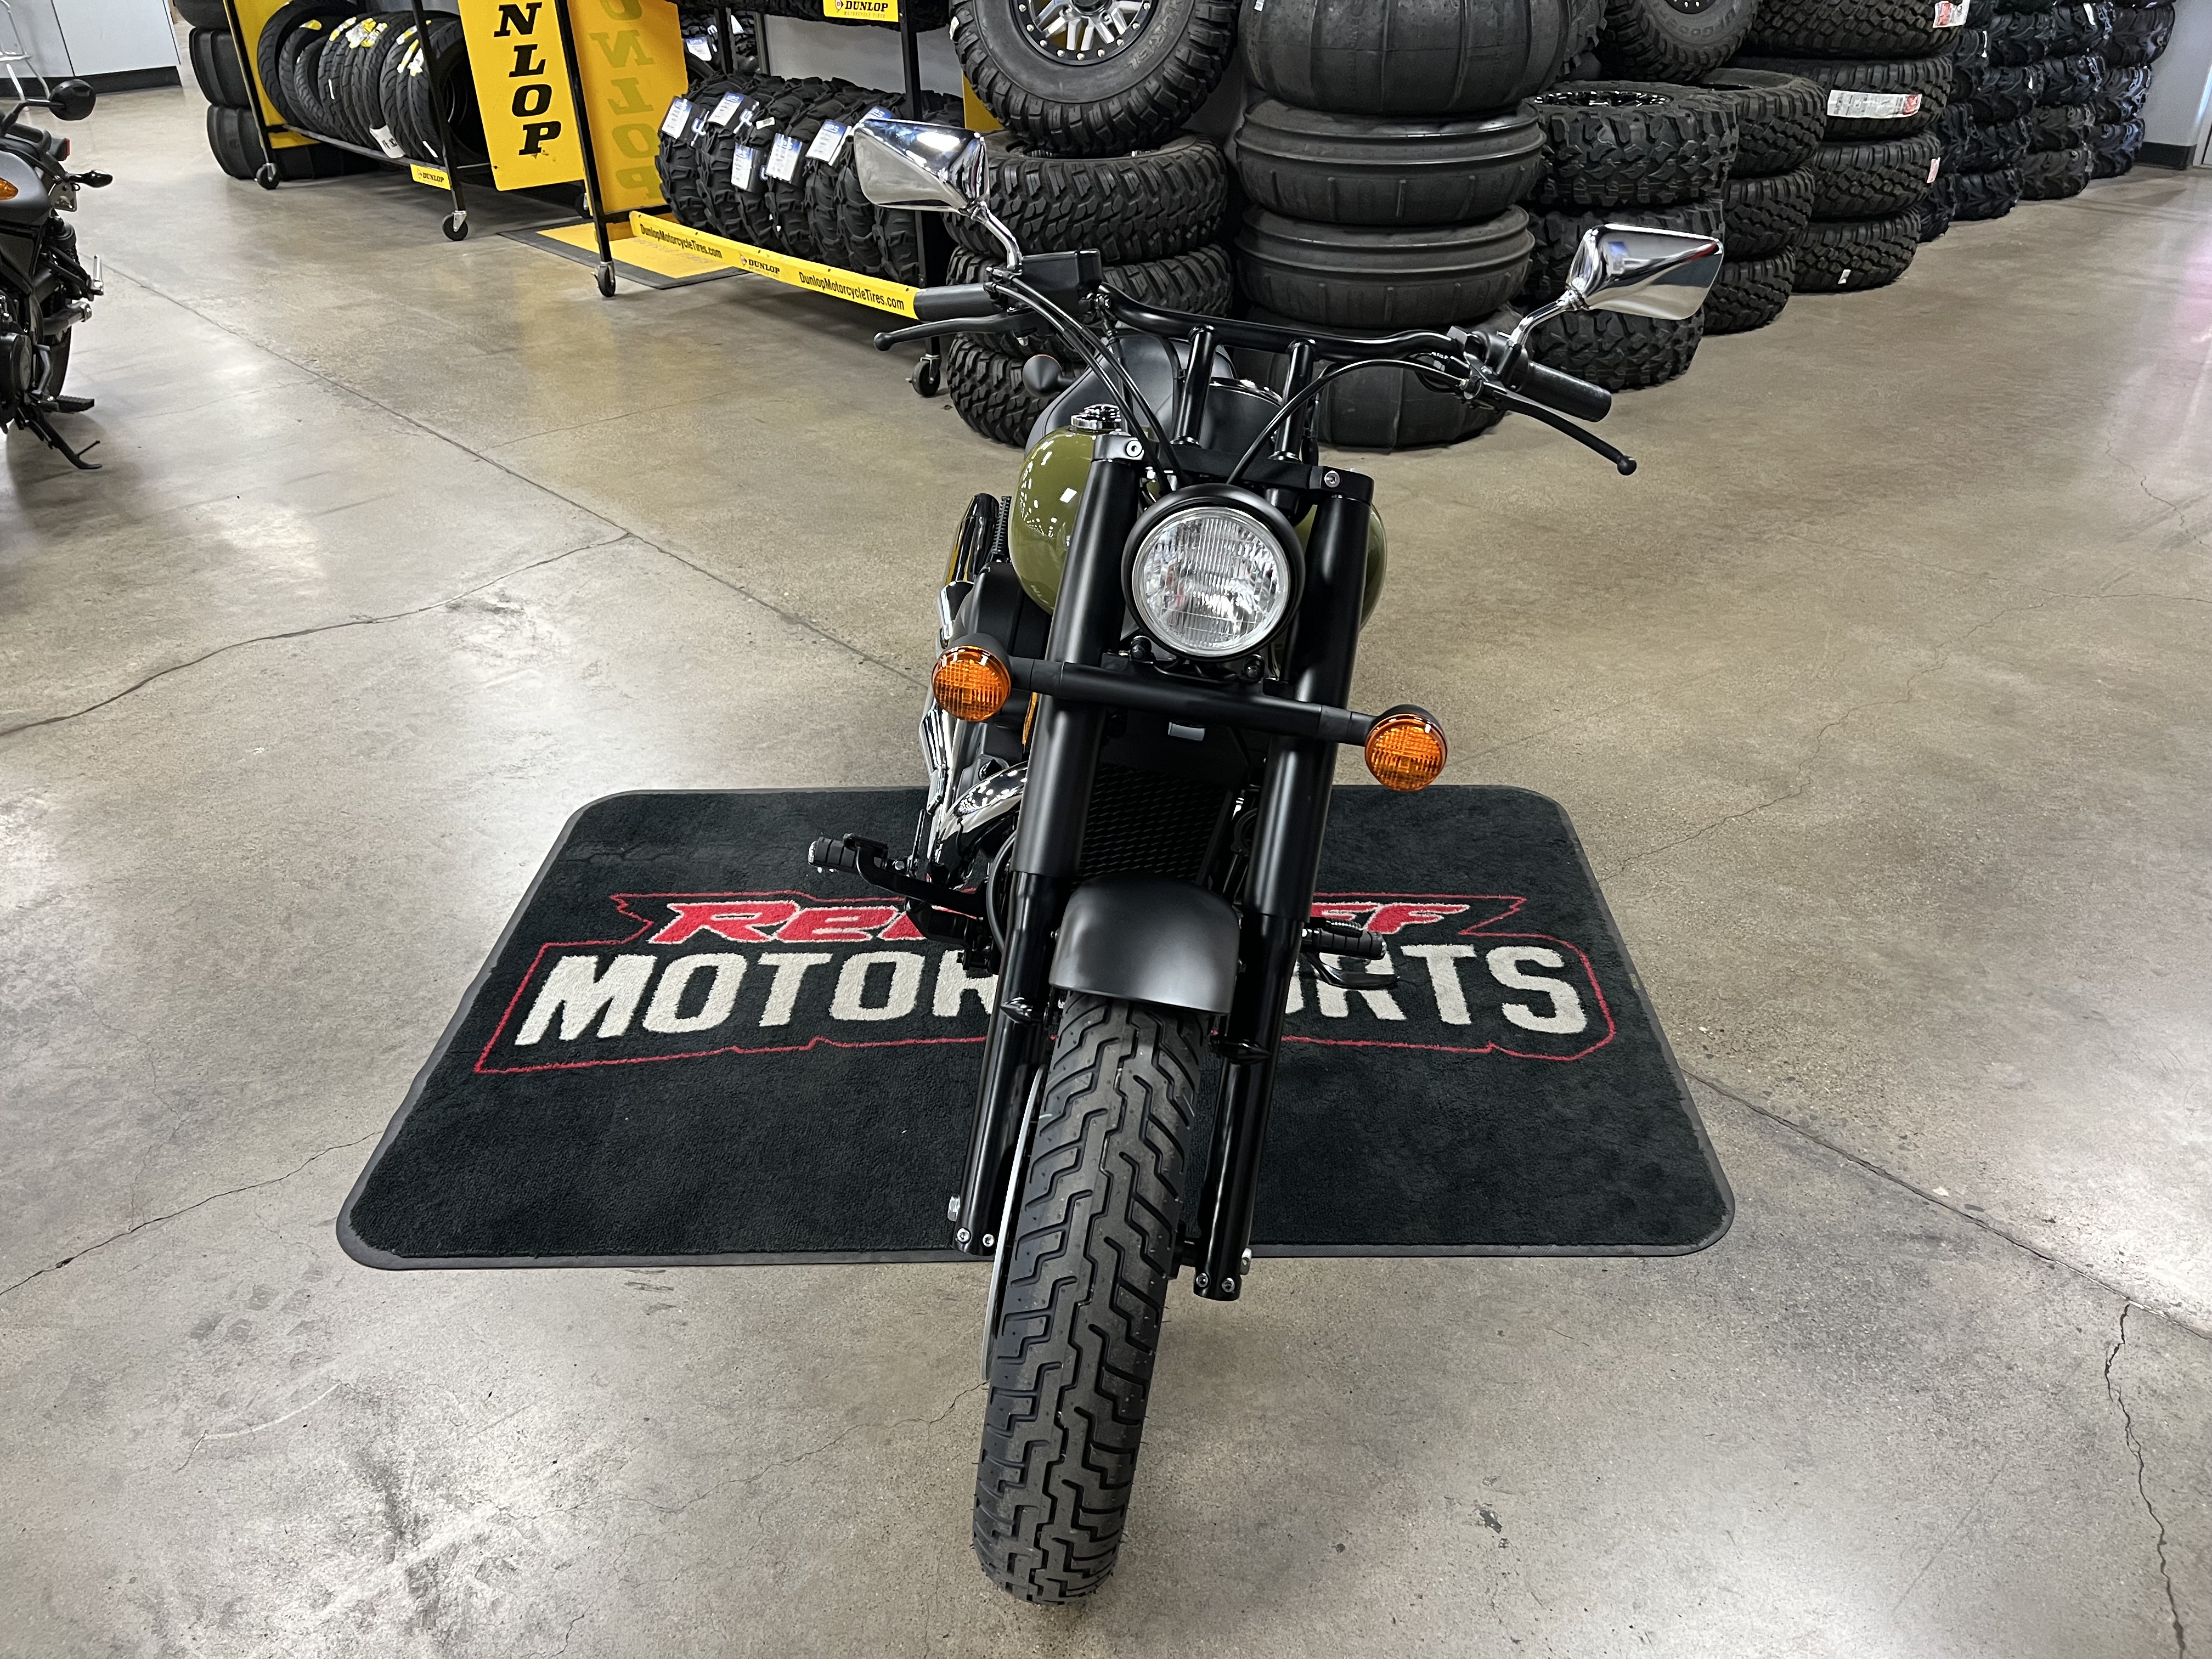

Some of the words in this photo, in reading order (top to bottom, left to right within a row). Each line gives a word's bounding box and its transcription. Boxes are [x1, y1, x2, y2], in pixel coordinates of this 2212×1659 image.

[845, 1, 888, 12] DUNLOP
[422, 172, 444, 183] DUNLOP
[640, 223, 723, 259] DunlopMotorcycleTires.com
[748, 259, 780, 274] DUNLOP
[799, 272, 905, 311] DunlopMotorcycleTires.com
